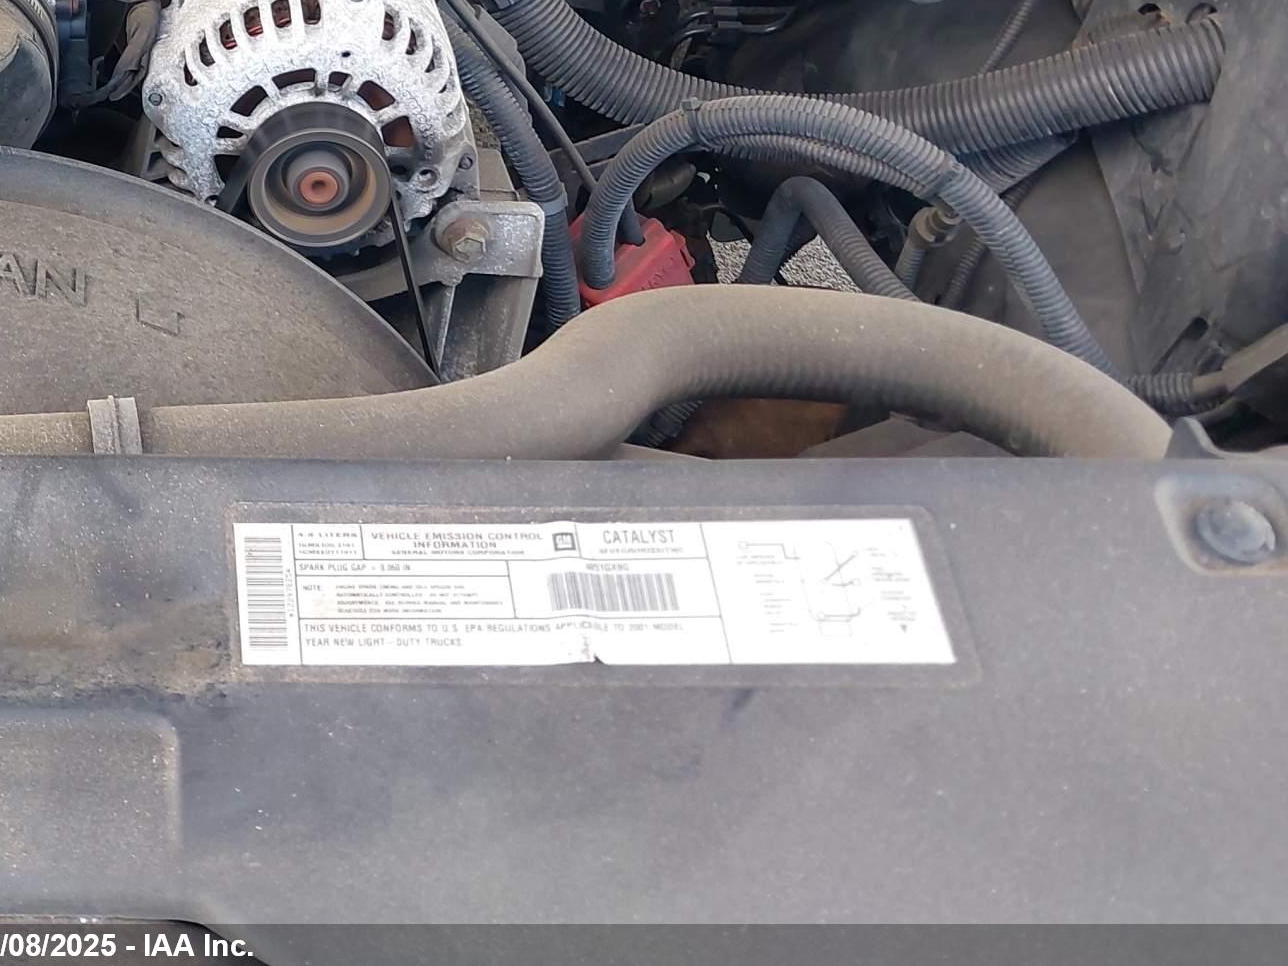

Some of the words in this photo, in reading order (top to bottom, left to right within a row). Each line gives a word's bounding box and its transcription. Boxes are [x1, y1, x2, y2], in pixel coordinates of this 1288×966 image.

[370, 531, 419, 541] VEHICLE
[424, 531, 484, 542] EMISSION
[487, 532, 543, 541] CONTROL
[602, 529, 674, 545] CATALYST
[412, 539, 497, 550] INFORMATION
[298, 562, 325, 572] SPARK
[327, 563, 349, 572] PLUG
[350, 563, 367, 572] GAP
[304, 623, 326, 633] THIS
[327, 623, 367, 633] VEHICLE
[370, 623, 423, 633] CONFORMS
[426, 623, 438, 633] TO
[465, 623, 483, 633] EPA
[486, 623, 551, 633] REGULATIONS
[305, 637, 330, 647] YEAR
[333, 637, 355, 647] NEW
[358, 637, 385, 647] LIGHT
[396, 637, 421, 647] DUTY
[425, 637, 461, 647] TRUCKS
